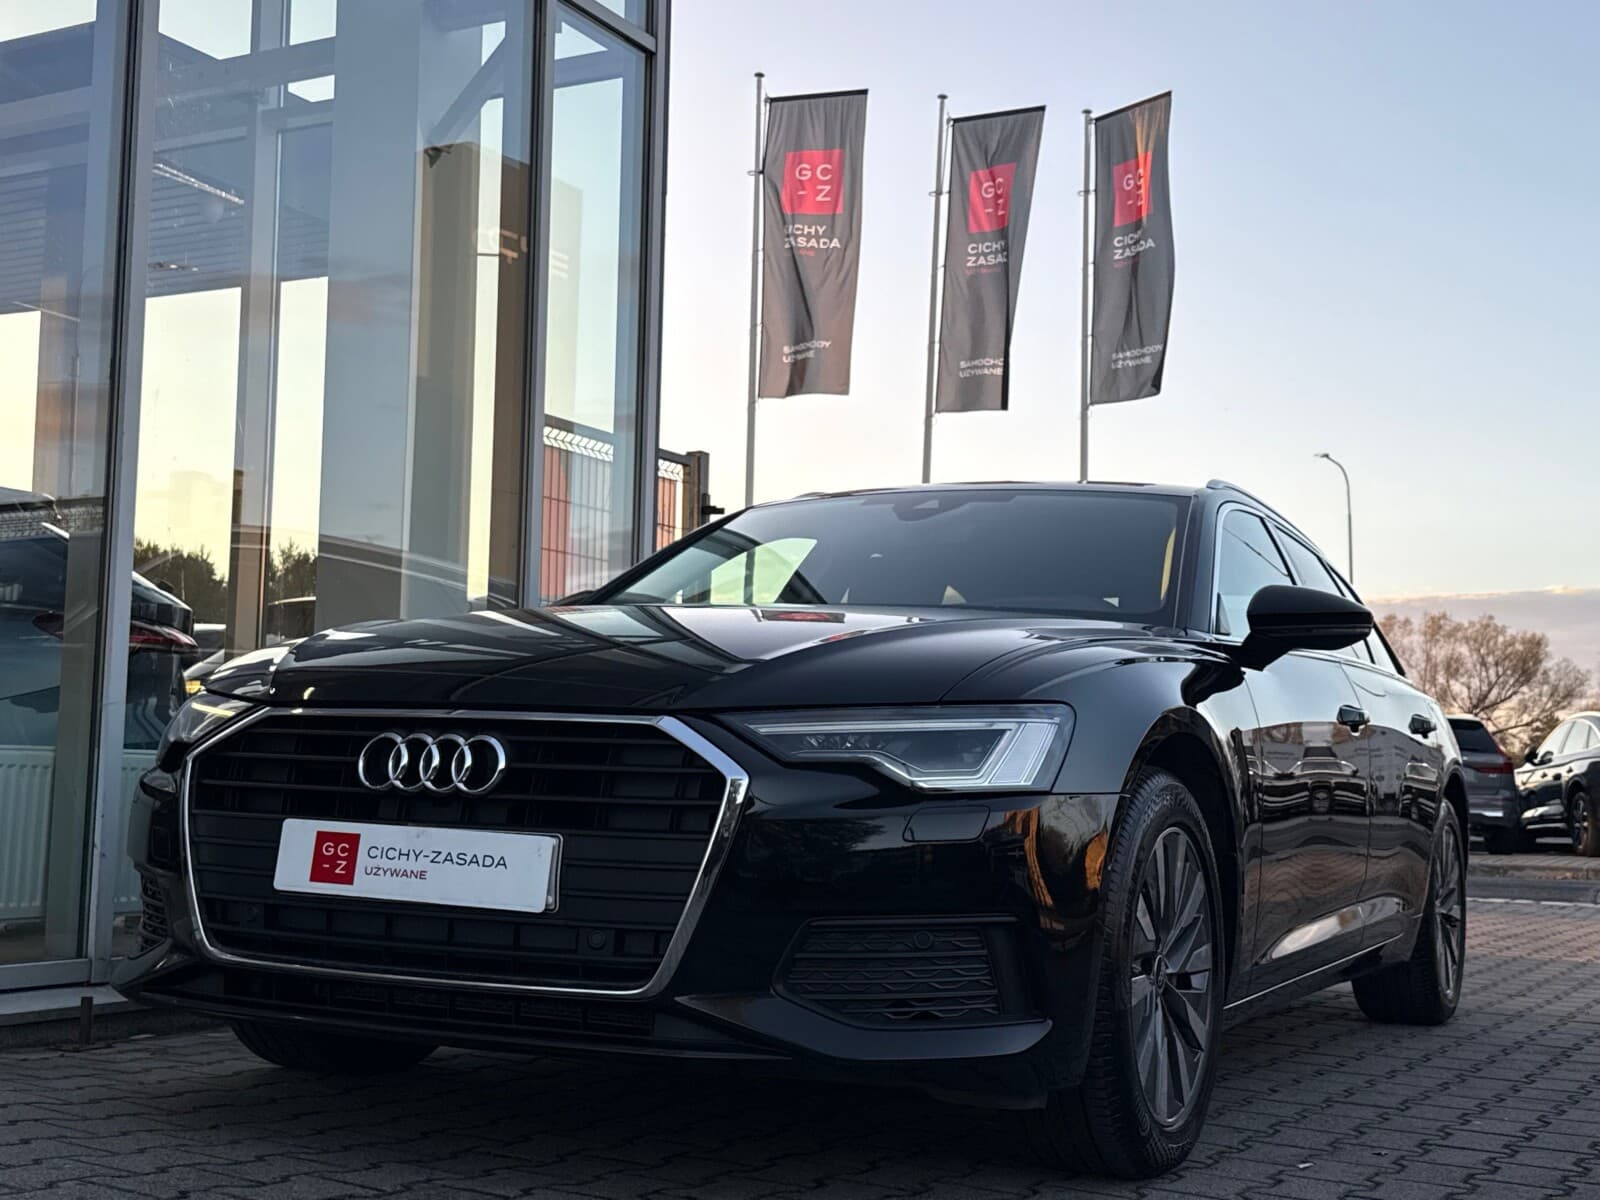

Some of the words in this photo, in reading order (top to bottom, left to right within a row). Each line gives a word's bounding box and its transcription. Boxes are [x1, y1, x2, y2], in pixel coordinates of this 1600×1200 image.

[795, 163, 833, 181] GC
[981, 178, 1004, 198] GC
[322, 842, 349, 857] GC
[367, 845, 508, 870] CICHY-ZASADA
[364, 865, 428, 881] UŻYWANE
